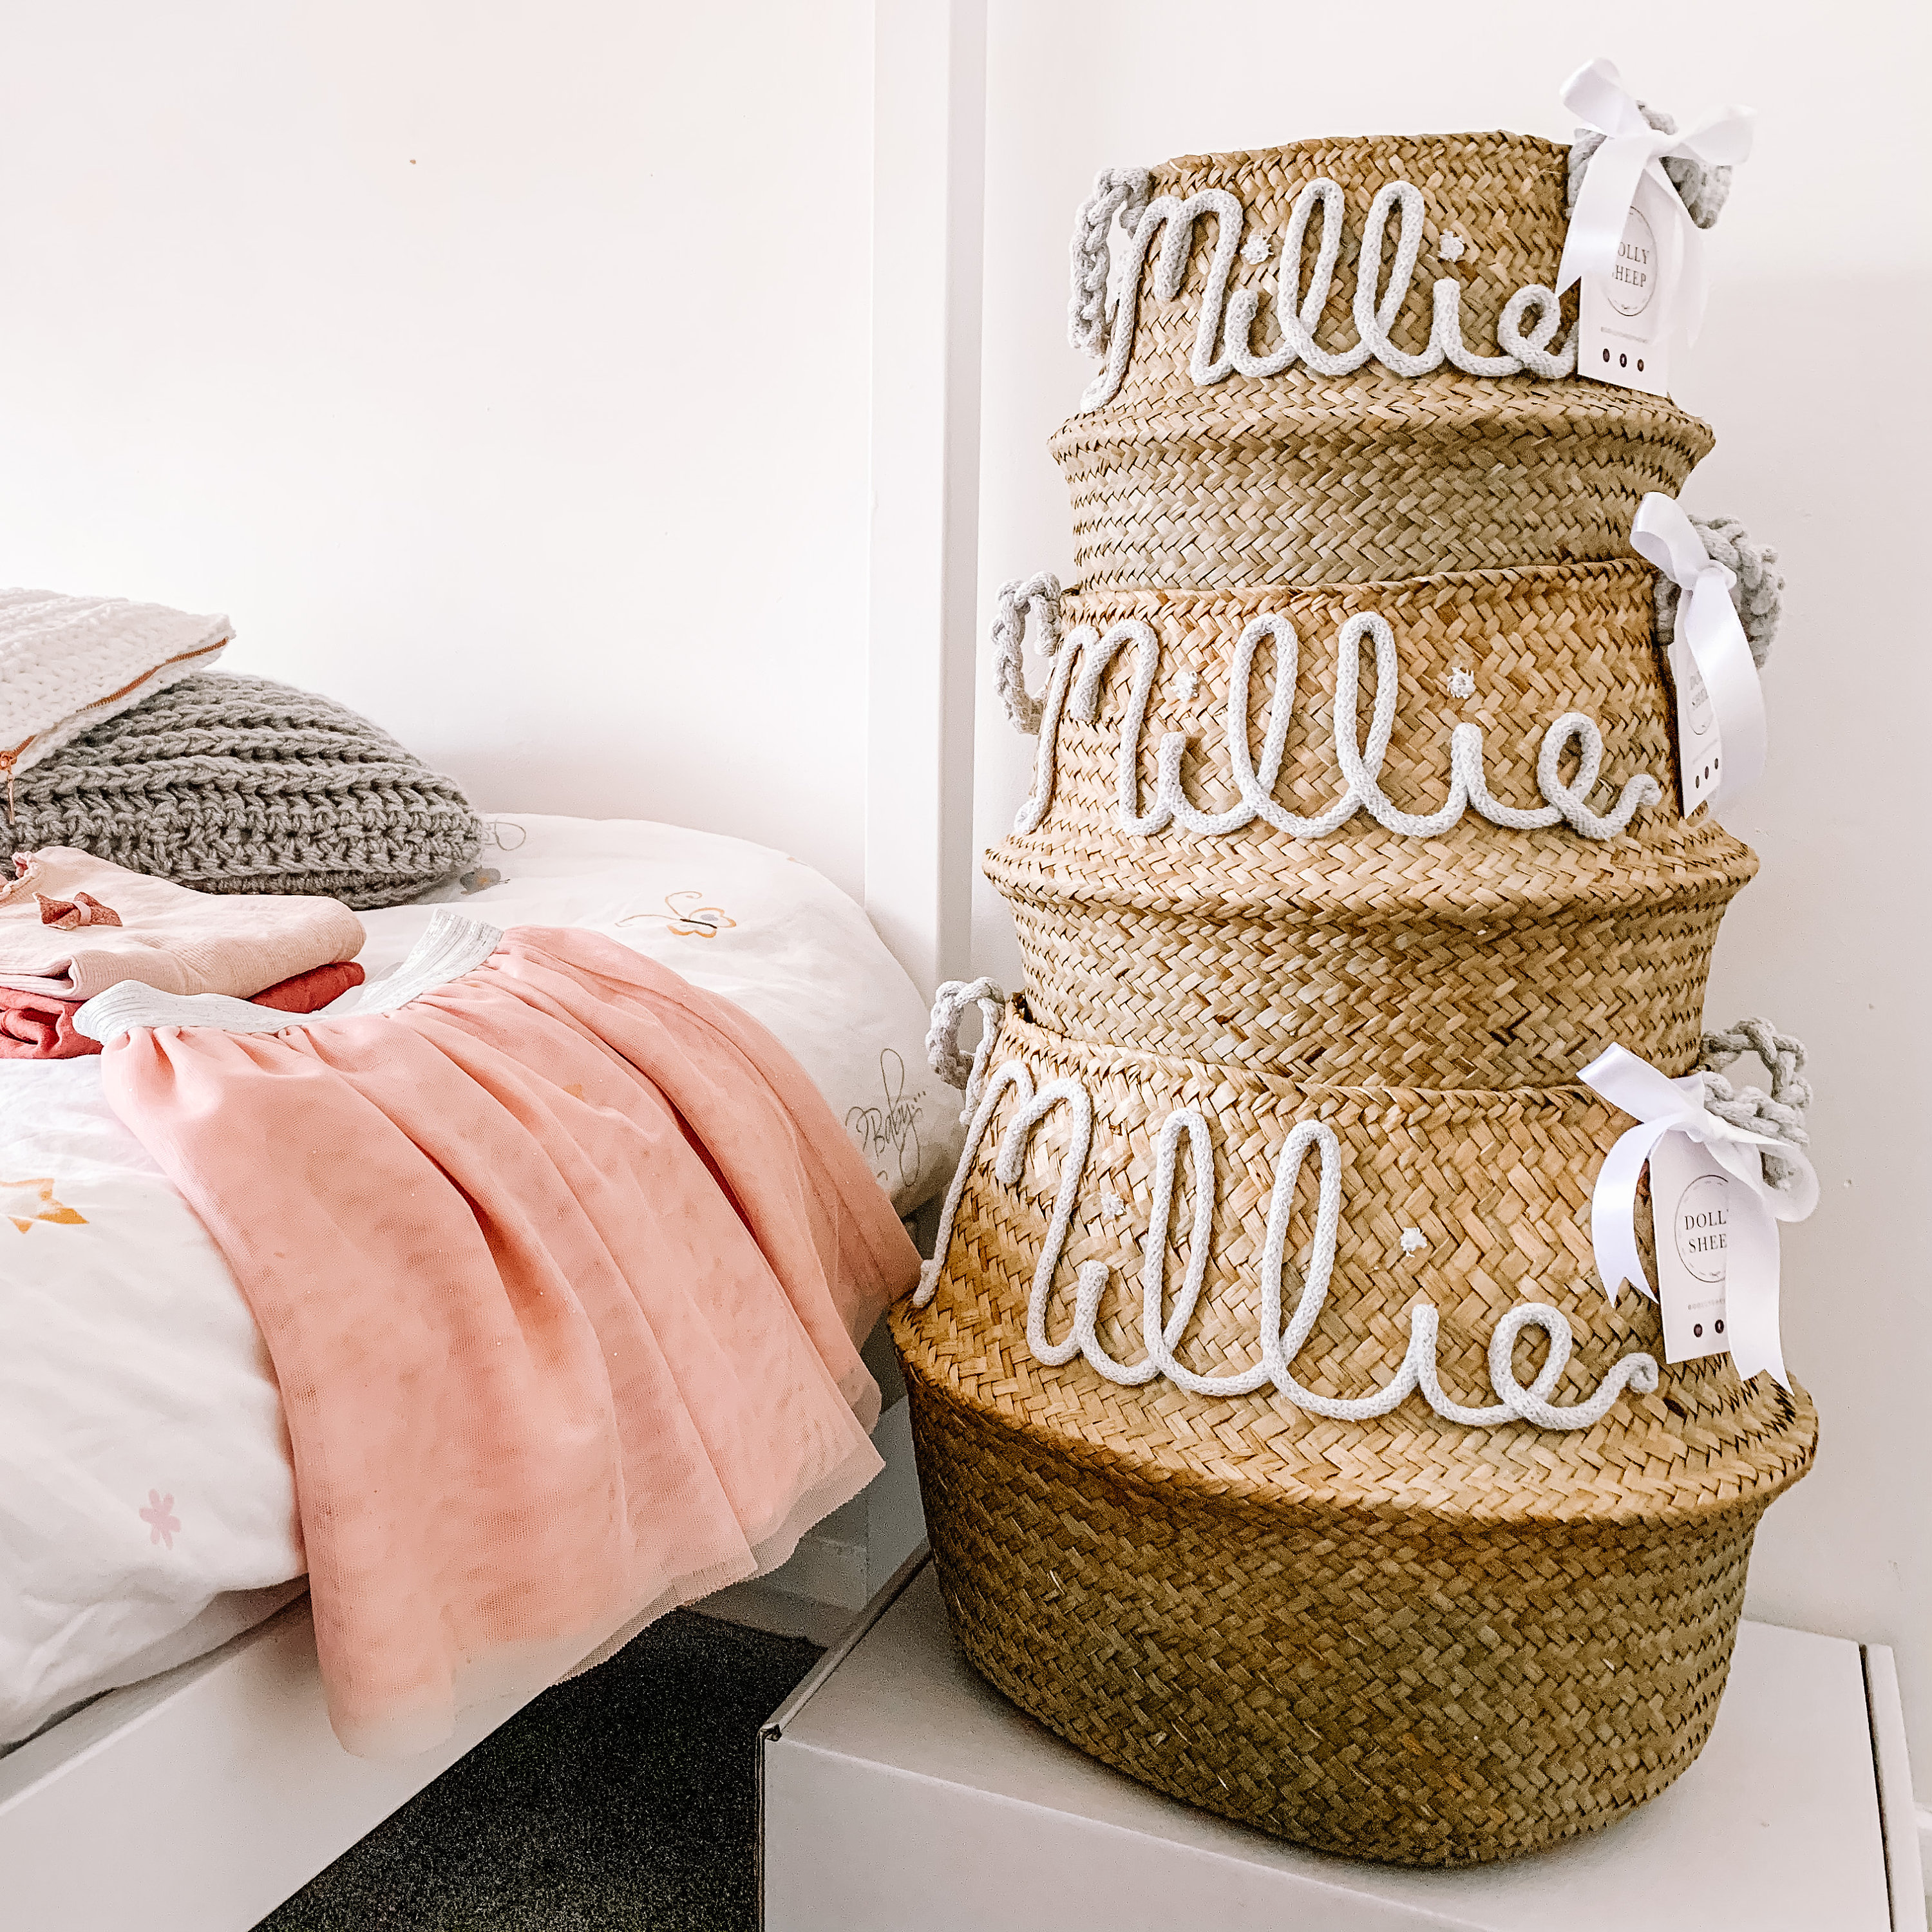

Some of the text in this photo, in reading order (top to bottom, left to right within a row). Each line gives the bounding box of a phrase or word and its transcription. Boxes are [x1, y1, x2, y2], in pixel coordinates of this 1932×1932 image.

[1618, 242, 1649, 264] OLLY
[1611, 265, 1646, 287] HEEP
[1080, 178, 1578, 413] Millie
[1014, 611, 1662, 840] Millie
[1684, 1209, 1729, 1230] DOLL
[913, 1060, 1658, 1430] Millie
[1689, 1233, 1727, 1253] SHEE
